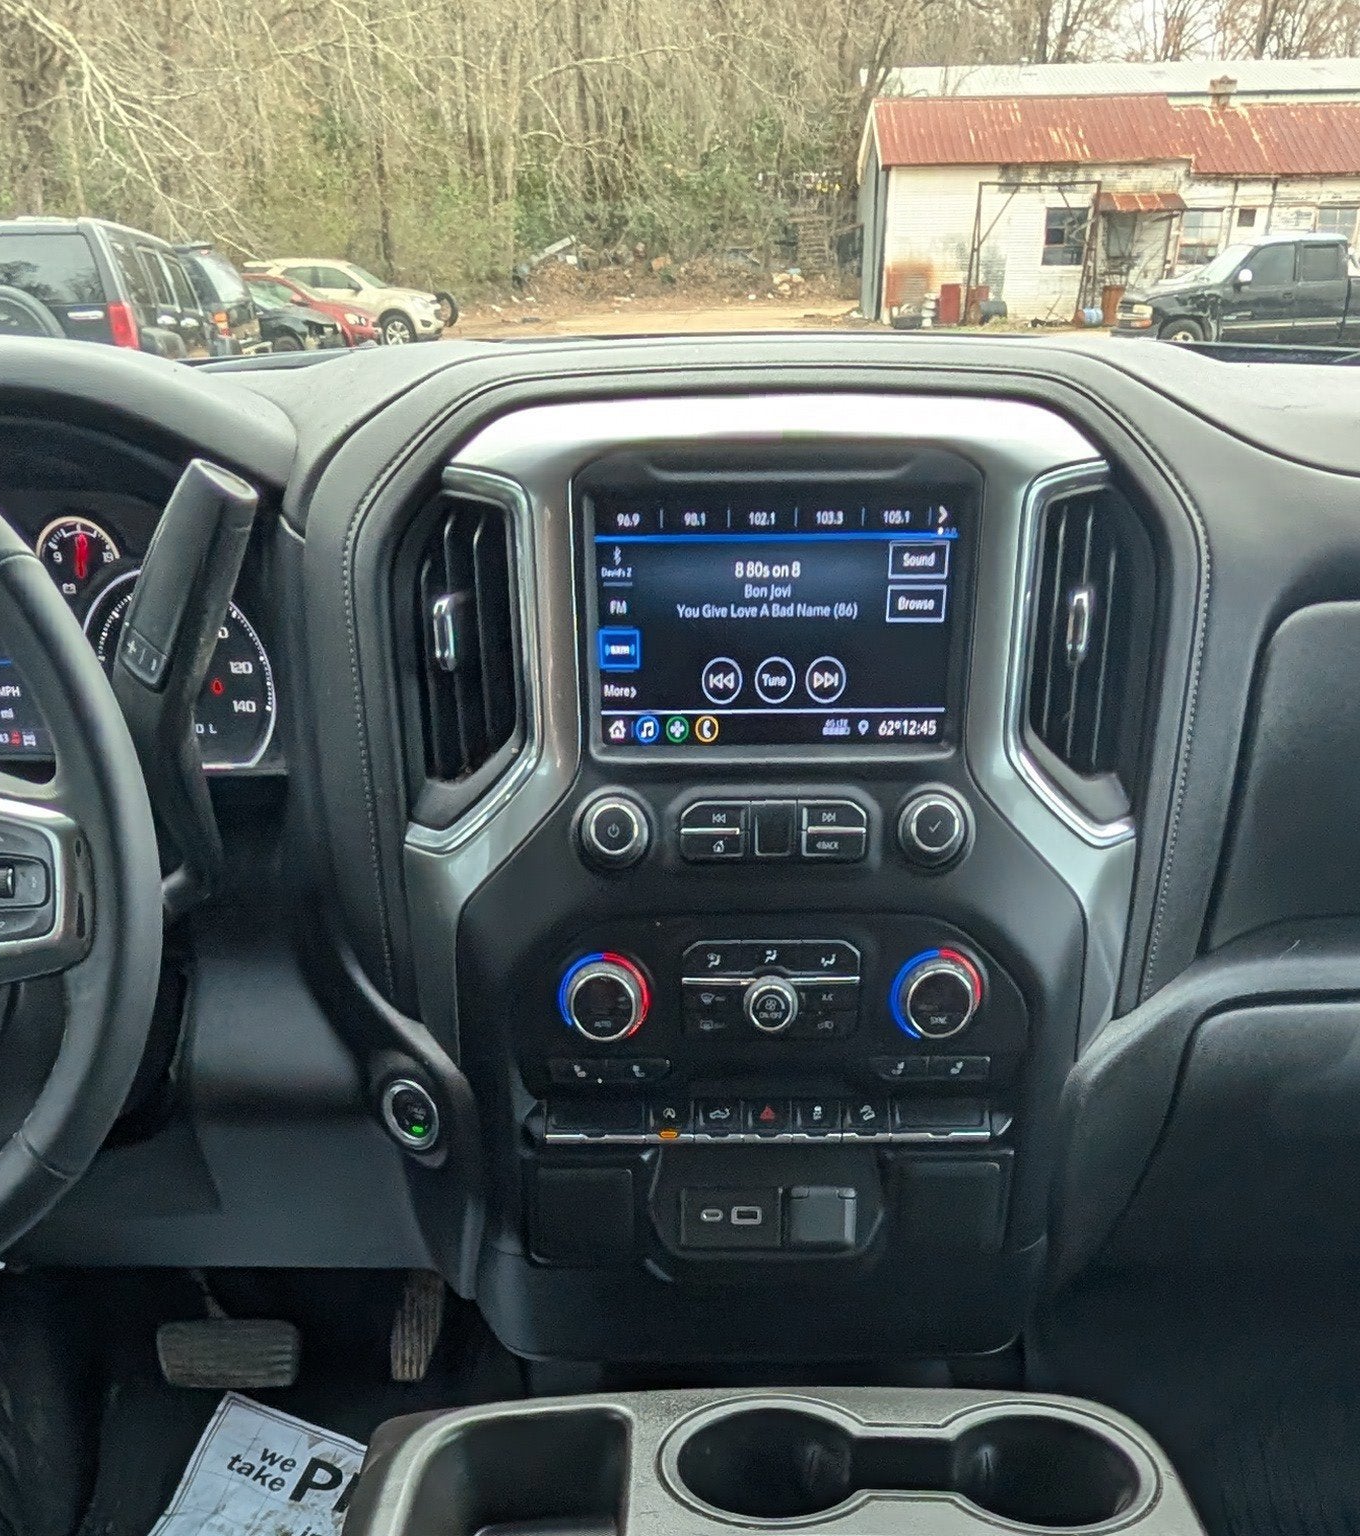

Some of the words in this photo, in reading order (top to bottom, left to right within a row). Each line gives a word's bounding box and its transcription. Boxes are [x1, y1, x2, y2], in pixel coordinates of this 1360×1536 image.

[749, 511, 776, 526] 102.1
[53, 551, 63, 563] 9
[102, 551, 114, 563] 19
[902, 551, 936, 567] Sound
[772, 564, 790, 578] on
[791, 560, 801, 578] 8
[744, 583, 768, 599] Bon
[769, 583, 792, 601] Jovi
[609, 600, 627, 614] FM
[676, 603, 700, 618] You
[702, 603, 728, 618] Give
[730, 603, 756, 618] Love
[759, 603, 770, 618] A
[771, 602, 794, 618] Bad
[796, 602, 831, 618] Name
[897, 595, 935, 611] Browse
[229, 661, 253, 674] 120
[761, 672, 788, 687] Tune
[603, 684, 630, 698] More
[232, 699, 257, 713] 140
[209, 723, 218, 733] L
[902, 718, 937, 736] 12:45
[260, 1448, 297, 1472] we
[226, 1453, 286, 1492] take
